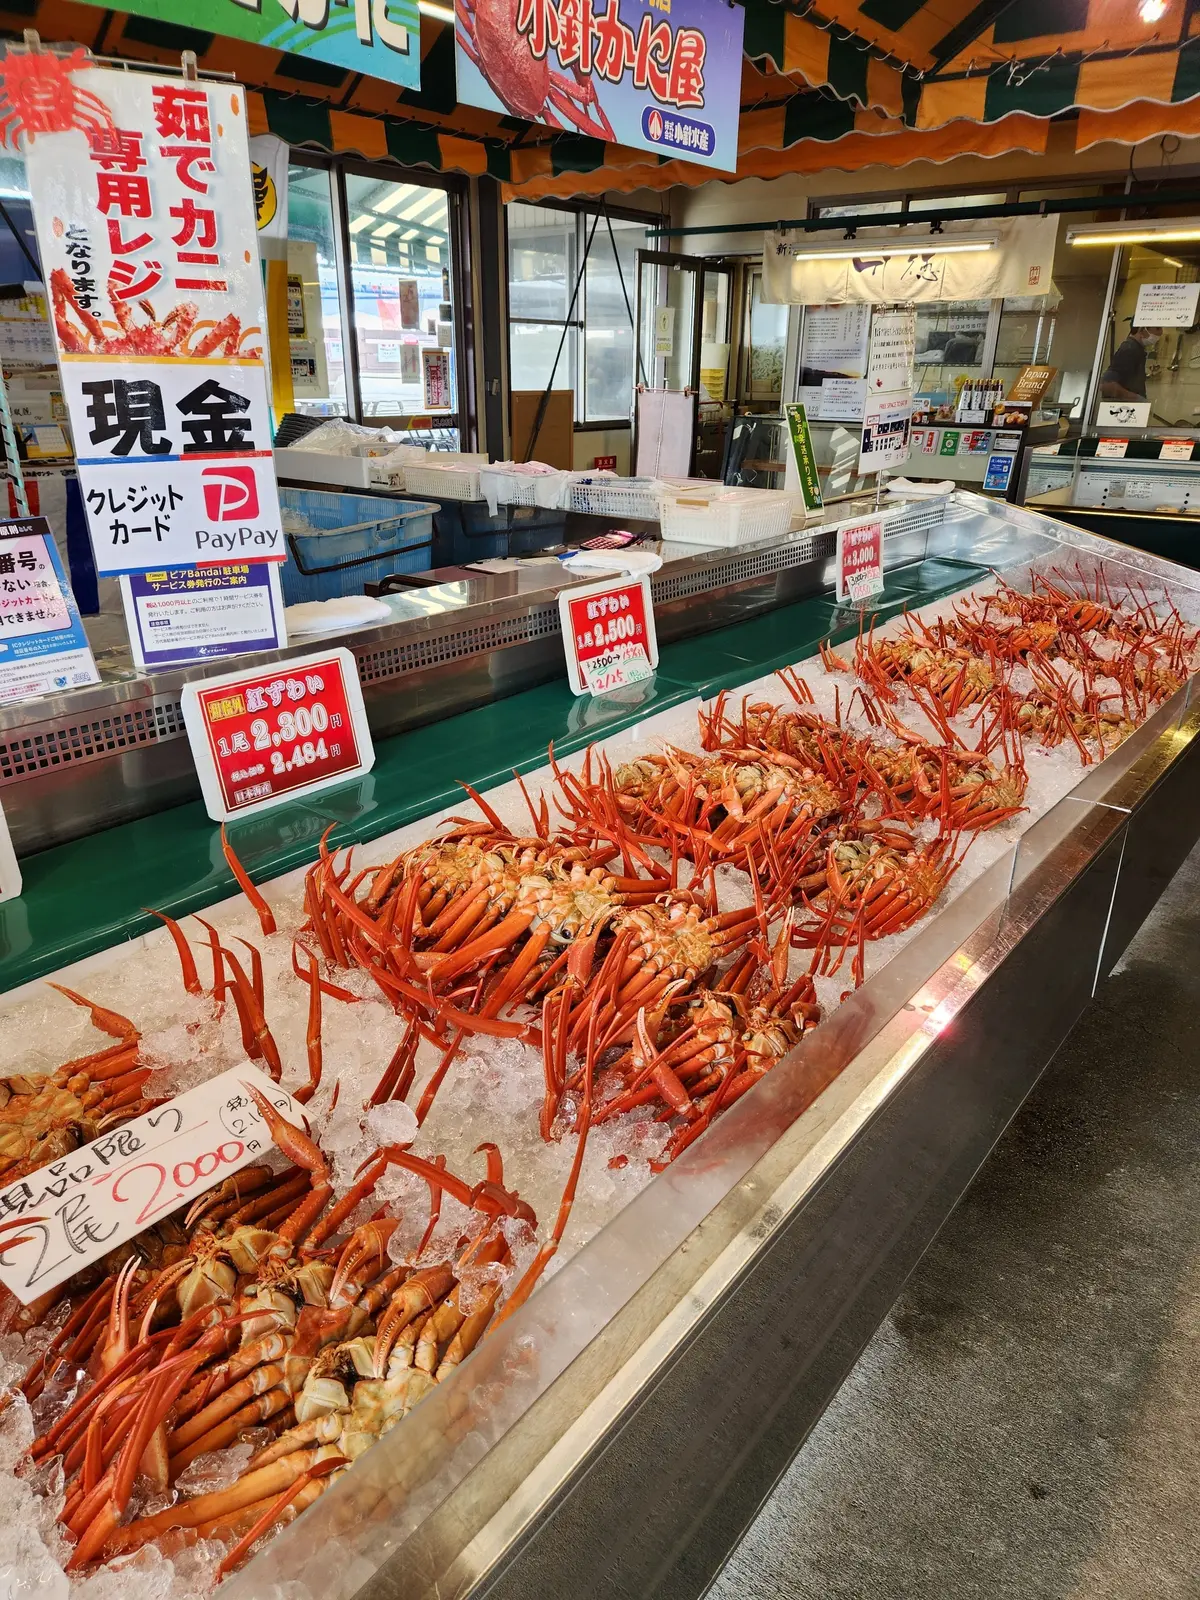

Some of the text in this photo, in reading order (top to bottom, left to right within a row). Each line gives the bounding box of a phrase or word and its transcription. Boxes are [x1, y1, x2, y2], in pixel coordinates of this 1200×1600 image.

[674, 122, 709, 151] 小針水産
[151, 85, 228, 293] 茹でカニ
[90, 127, 162, 302] 専用レジ
[65, 223, 102, 318] となります。
[1017, 378, 1046, 389] Brand
[1021, 367, 1049, 379] Japan
[81, 379, 255, 456] 現金
[86, 484, 184, 515] クレジット
[110, 513, 171, 545] カード
[195, 525, 279, 552] PayPay
[151, 576, 247, 591] サービス券発行のご案内
[586, 595, 630, 620] 紅ずわい
[245, 675, 325, 712] 紅ずわい
